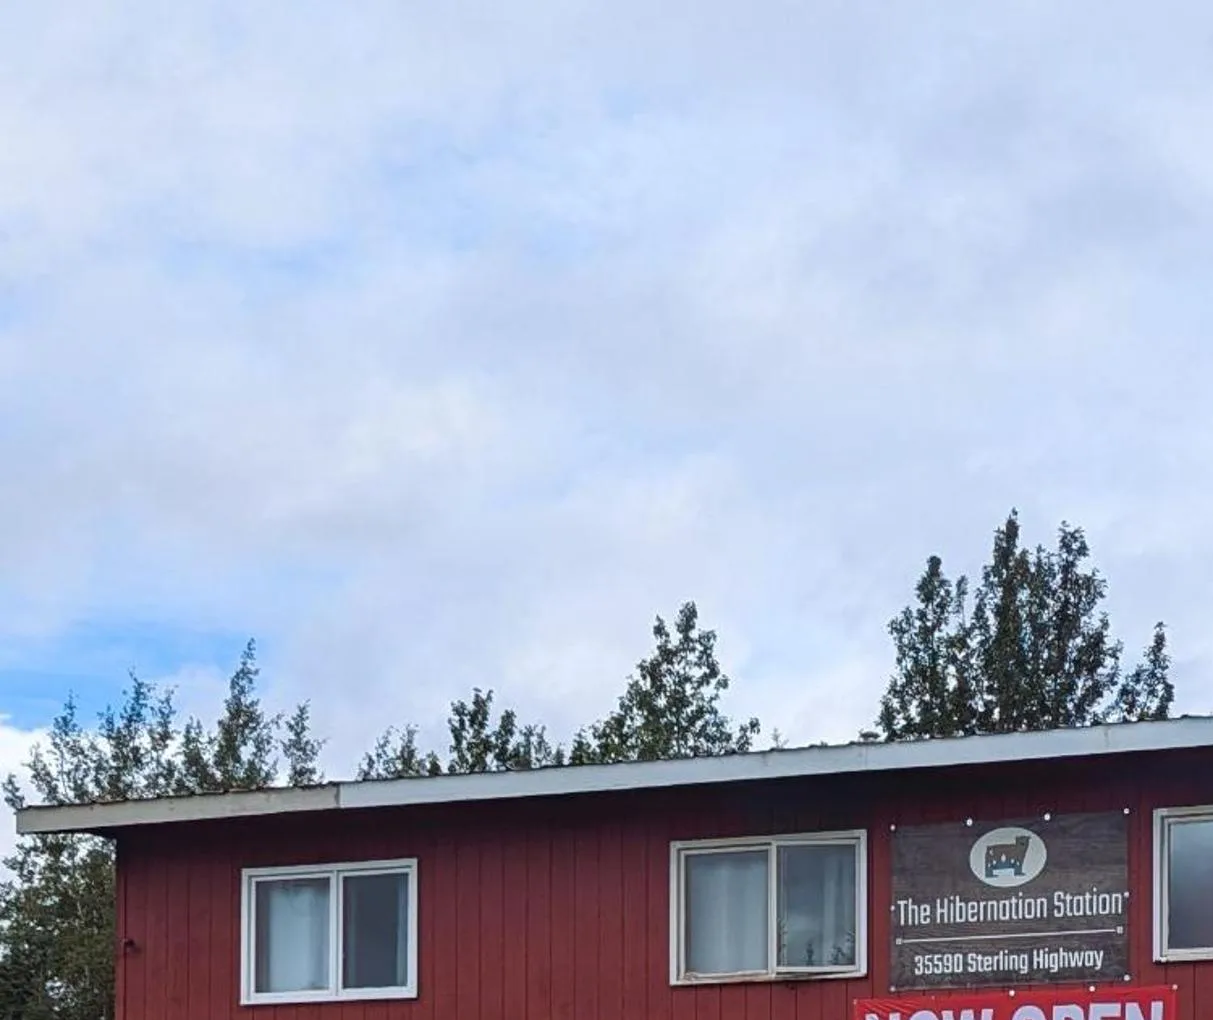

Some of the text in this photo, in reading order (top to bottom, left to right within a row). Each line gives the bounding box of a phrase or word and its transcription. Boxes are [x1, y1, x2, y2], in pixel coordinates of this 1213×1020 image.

[897, 887, 1123, 926] The Hibernation Station
[914, 947, 1104, 976] 35590 Sterling Highway
